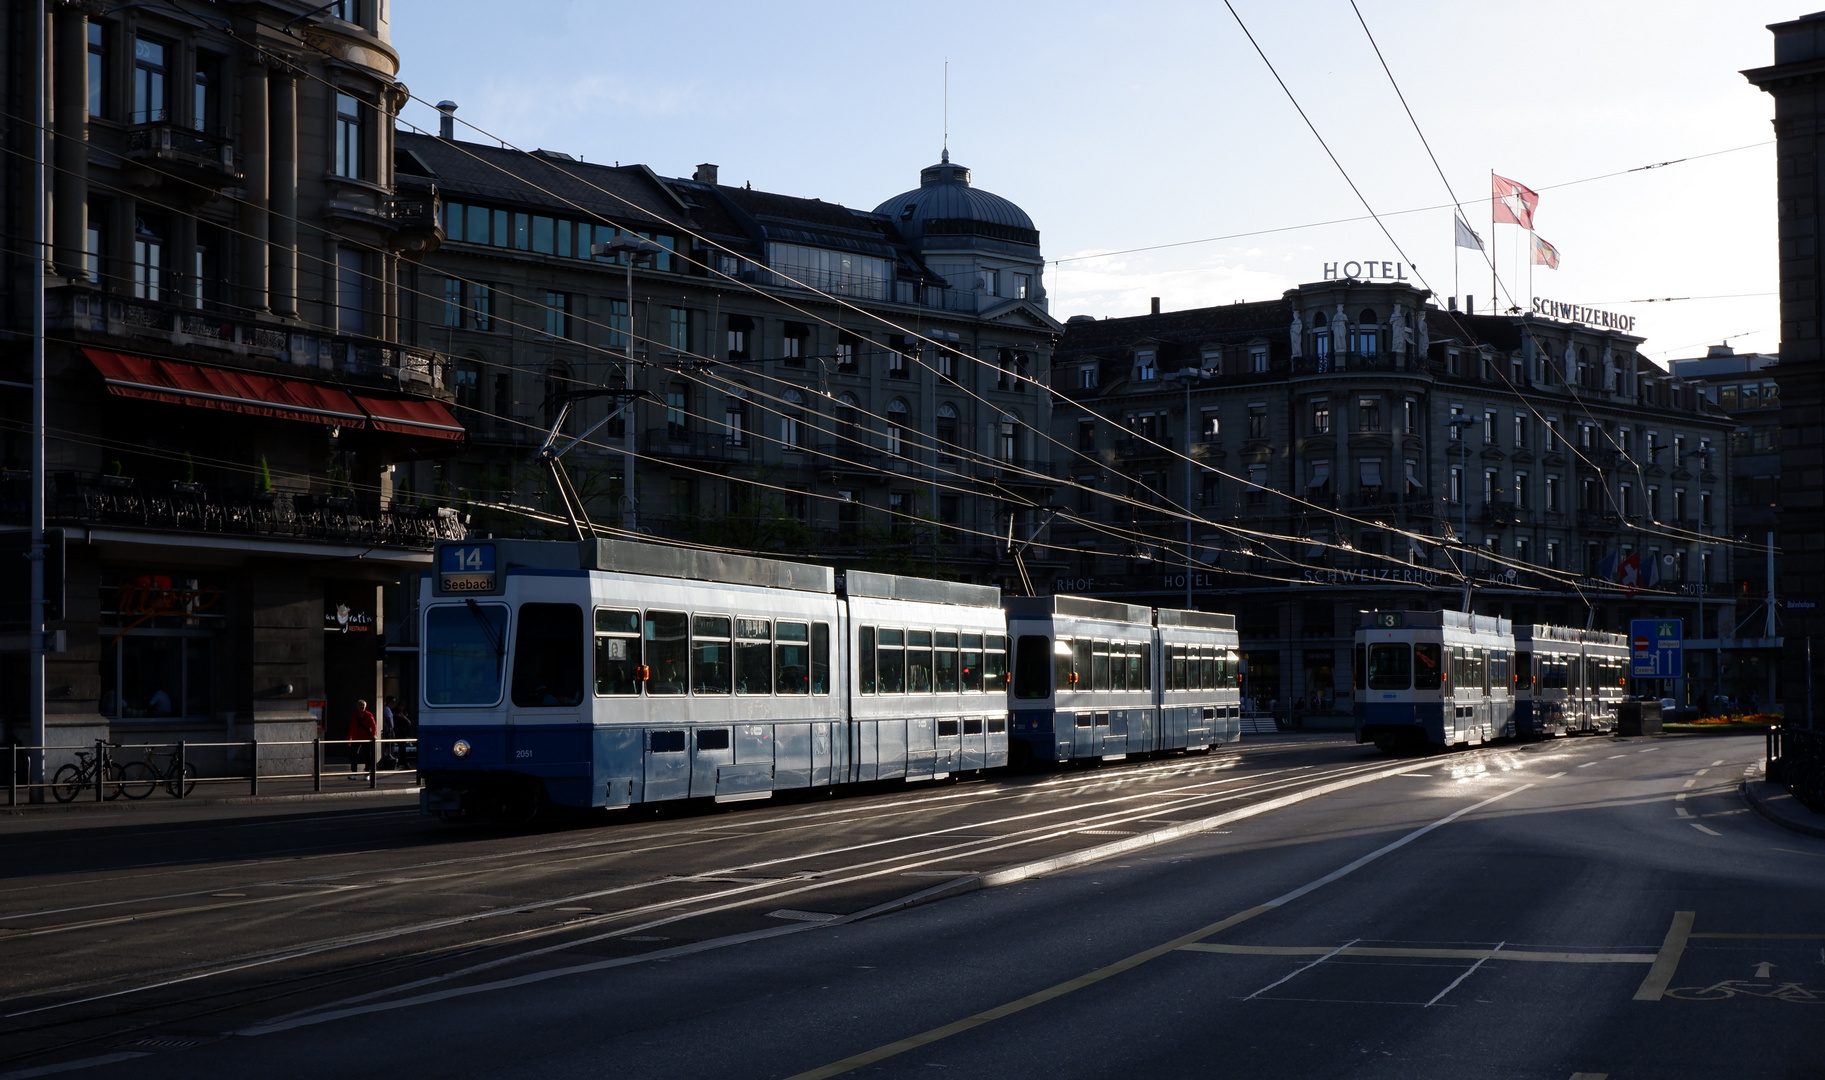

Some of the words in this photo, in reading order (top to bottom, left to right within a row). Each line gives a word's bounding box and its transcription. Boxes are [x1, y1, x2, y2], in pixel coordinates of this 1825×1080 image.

[1323, 261, 1408, 280] HOTEL
[1532, 297, 1636, 331] SCHWEIZERHOF
[454, 547, 483, 571] 14
[1304, 569, 1439, 583] SCHWEIZERHOF
[443, 579, 493, 590] Seebach
[1052, 578, 1095, 591] RHOF
[325, 613, 336, 621] au
[1385, 614, 1395, 627] 3
[516, 750, 533, 758] 2051
